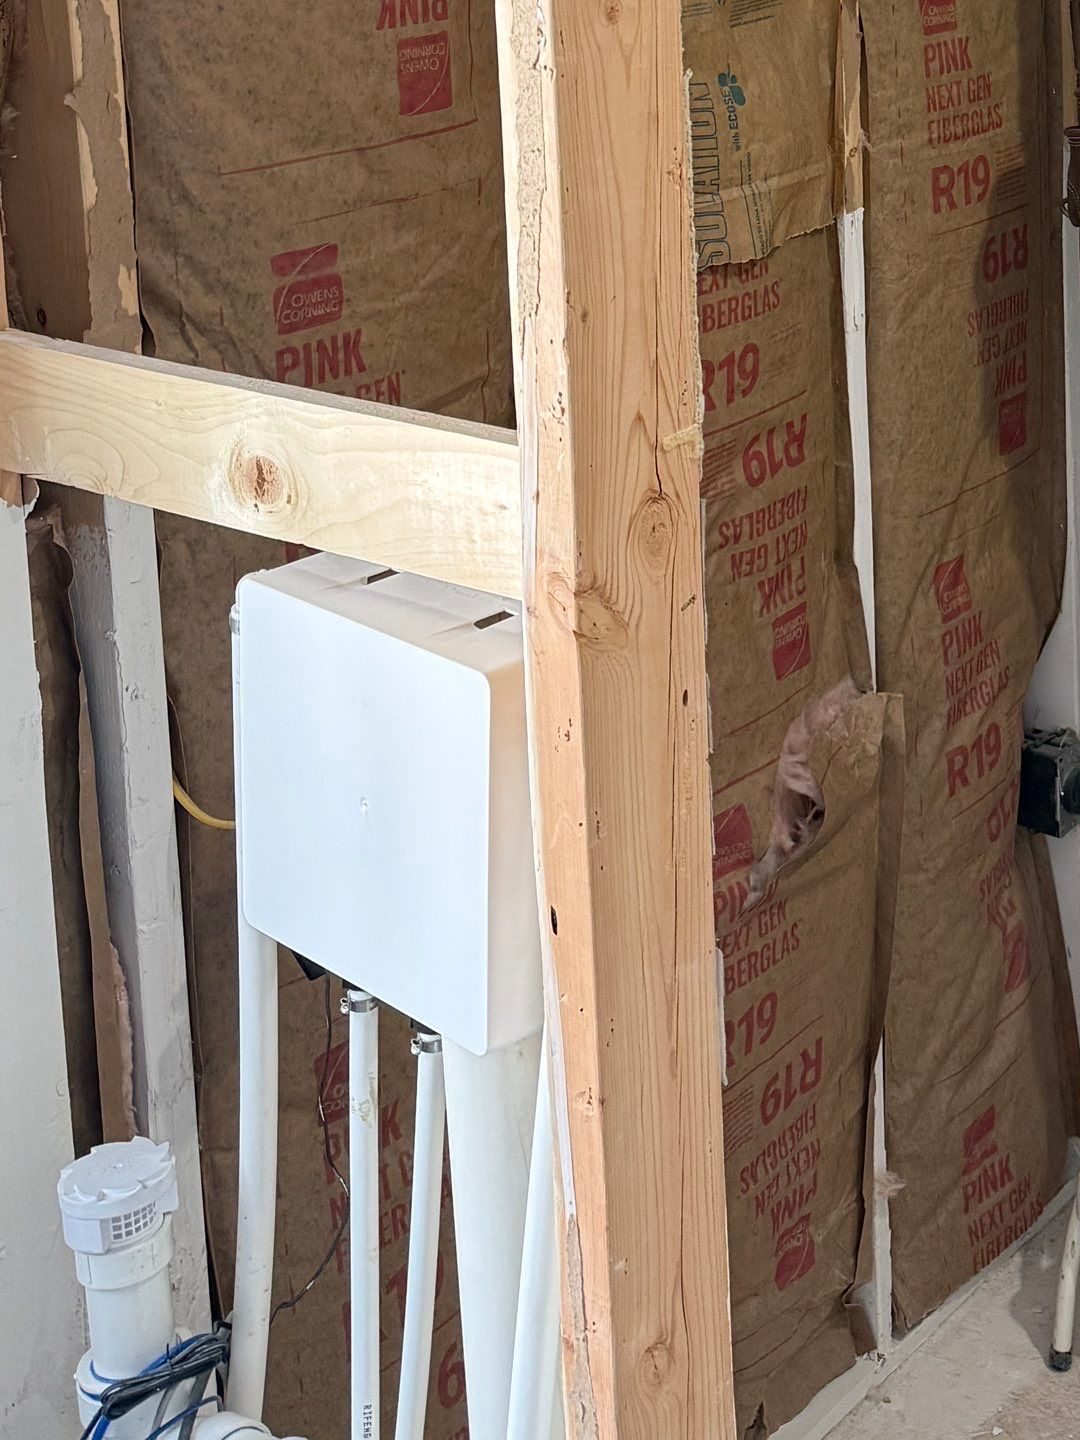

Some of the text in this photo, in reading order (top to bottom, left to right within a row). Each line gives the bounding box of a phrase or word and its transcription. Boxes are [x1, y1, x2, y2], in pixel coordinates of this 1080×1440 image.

[924, 37, 972, 78] PINK
[720, 88, 738, 131] ECOSE
[925, 76, 992, 112] NEXT GEN
[928, 106, 1002, 149] FIBERGLAS
[931, 155, 991, 214] R19
[698, 266, 729, 297] EXT
[982, 223, 1028, 284] R19
[281, 301, 340, 325] CORNING
[291, 287, 339, 308] OWENS
[701, 278, 781, 334] BERGLAS
[967, 288, 1029, 337] FIBERGLAS
[274, 328, 366, 387] PINK
[1003, 319, 1027, 353] NEXT
[994, 350, 1027, 398] PINK
[742, 412, 808, 488] R19
[717, 485, 808, 550] FIBERGLAS
[730, 520, 808, 582] NEXT GEN
[757, 557, 806, 618] PINK
[941, 611, 984, 667] PINK
[945, 640, 1001, 697] NEXT GEN
[945, 722, 1002, 798] R19
[719, 897, 787, 959] EXT GEN
[725, 923, 799, 994] BERGLAS
[760, 1037, 822, 1126] R19
[962, 1152, 1014, 1215] PINK
[967, 1173, 1032, 1247] NEXT GEN
